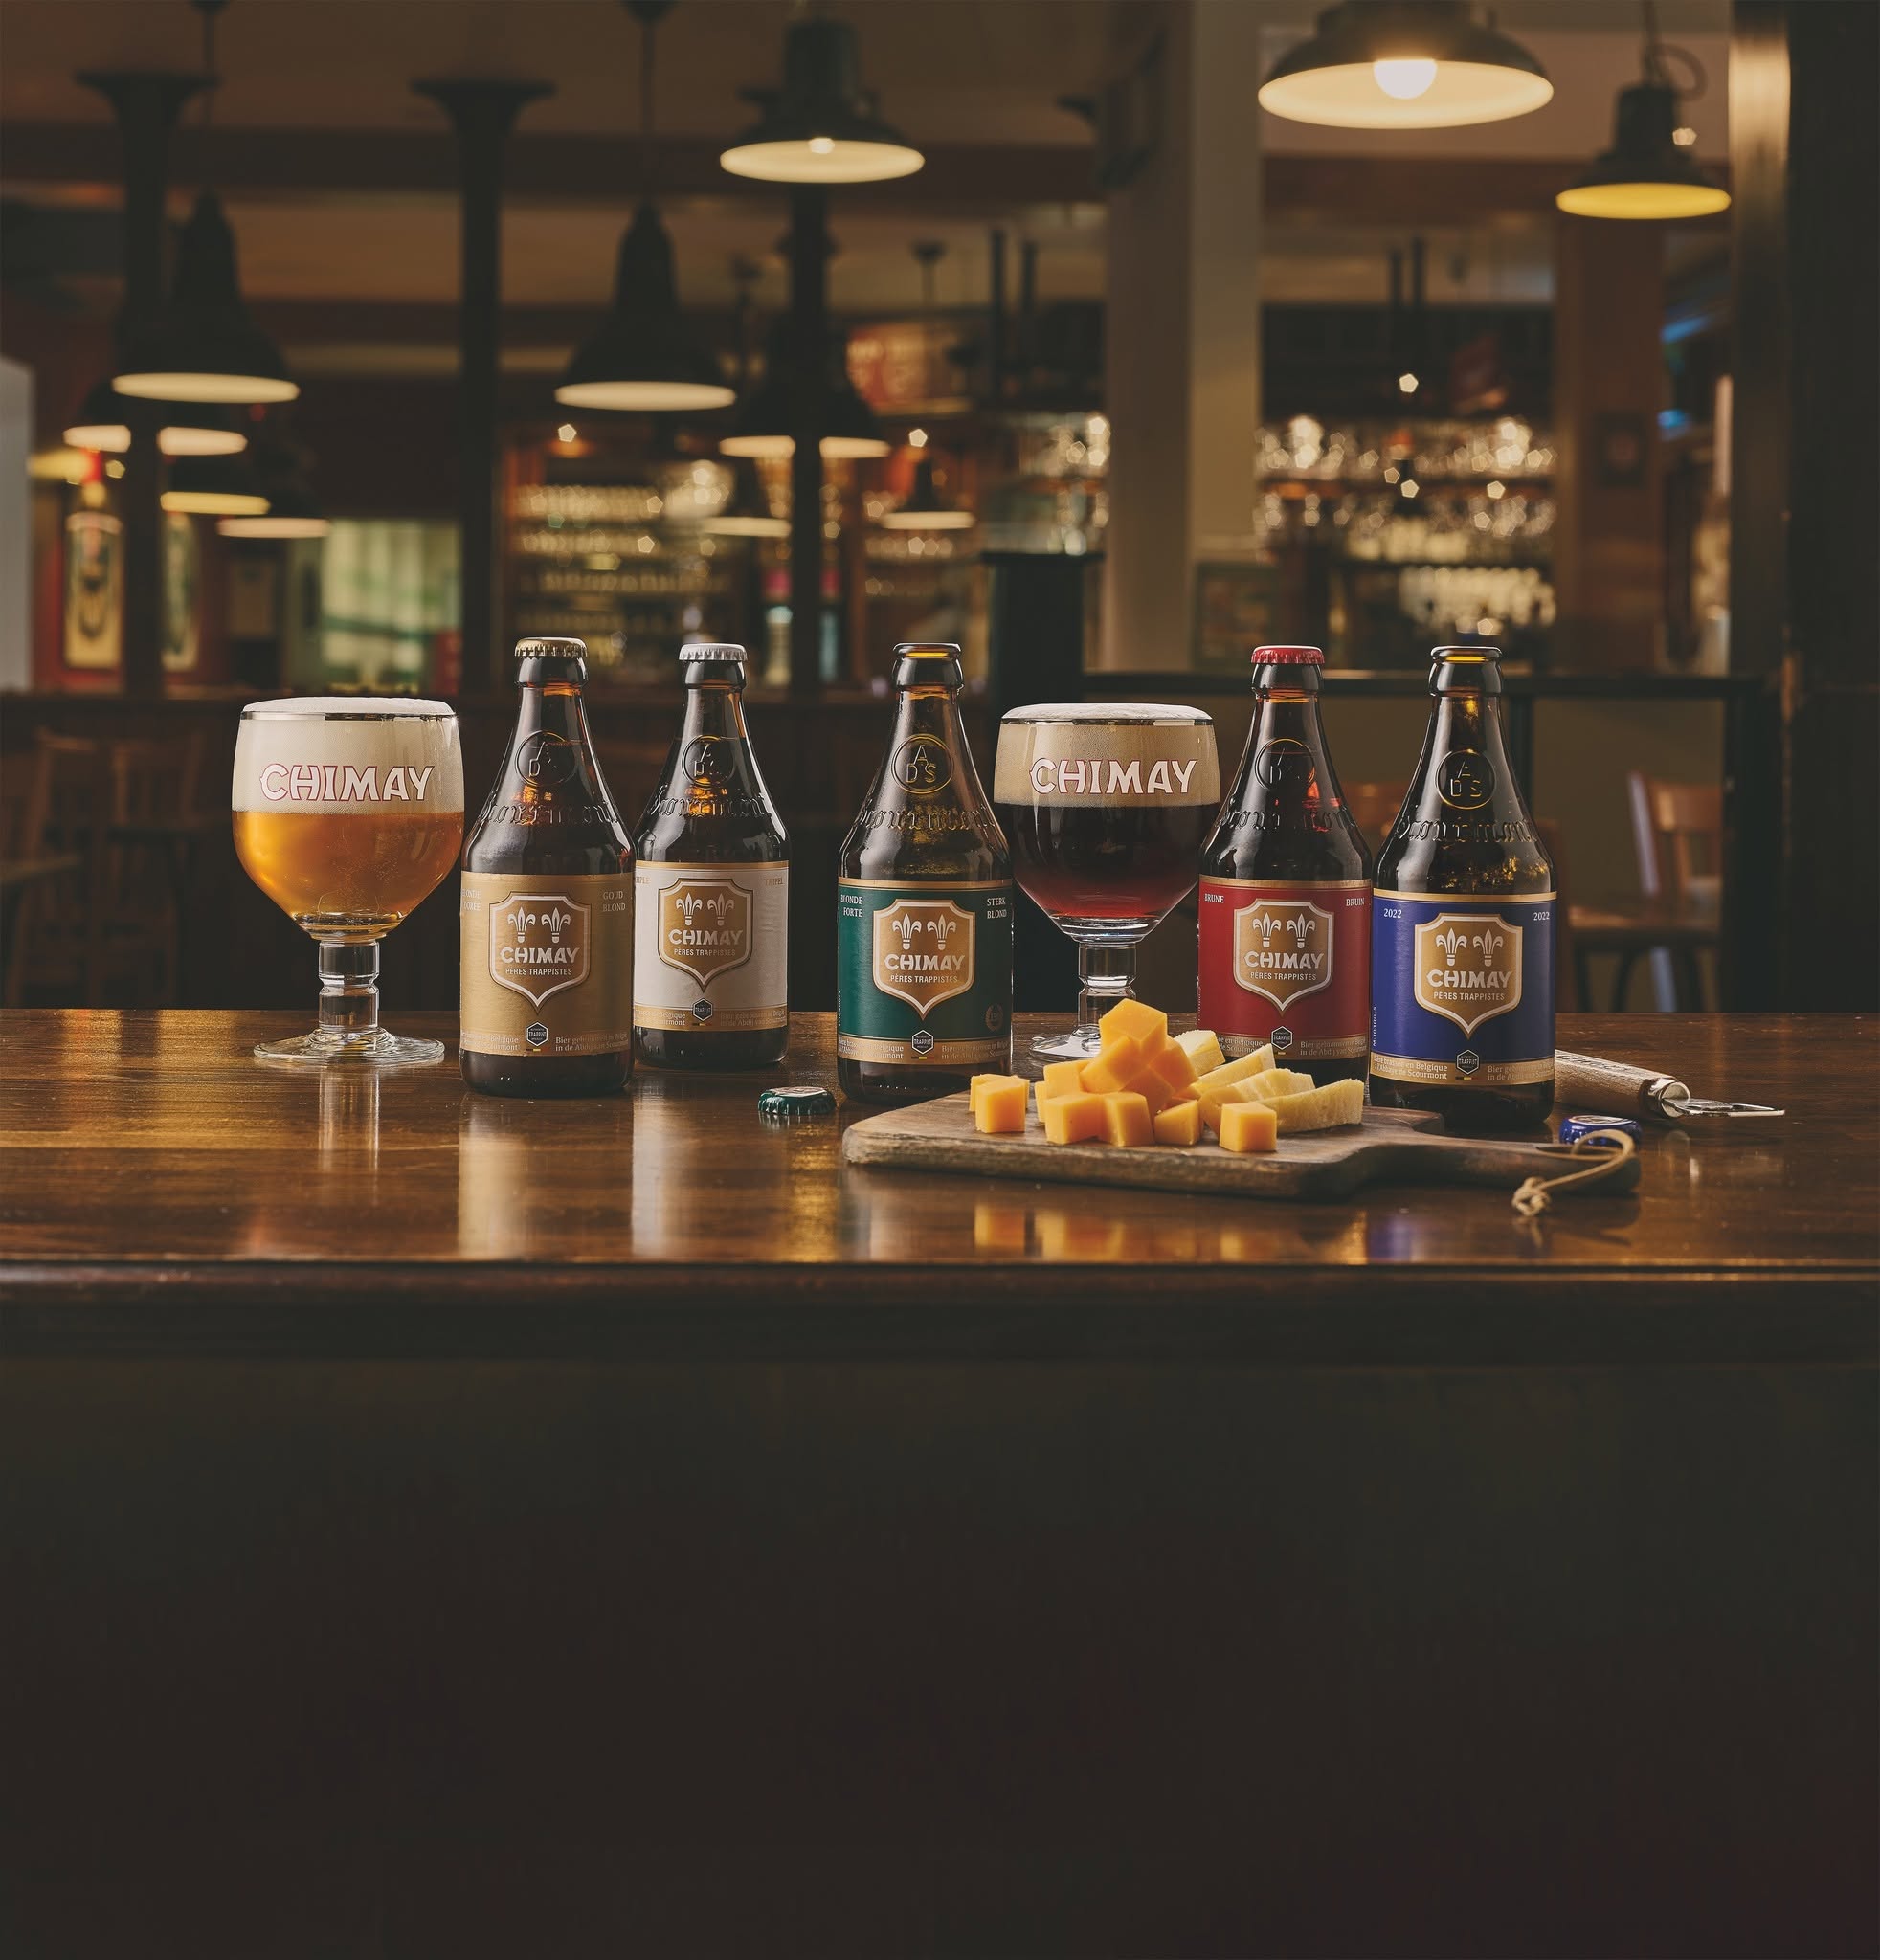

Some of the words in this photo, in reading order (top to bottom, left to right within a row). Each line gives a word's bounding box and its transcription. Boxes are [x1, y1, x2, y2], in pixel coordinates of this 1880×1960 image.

[1029, 757, 1197, 794] CHIMAY
[259, 764, 435, 801] CHIMAY
[603, 890, 623, 899] GOUD
[840, 894, 862, 904] BLONDE
[1205, 894, 1224, 903] BRUNE
[987, 897, 1006, 906] STERK
[1346, 898, 1364, 906] BRUIN
[602, 903, 626, 912] BLOND
[843, 907, 862, 917] FORTE
[987, 910, 1007, 919] BLOND
[1384, 908, 1402, 919] 2022
[1533, 911, 1550, 921] 2022
[668, 929, 744, 946] CHIMAY
[500, 947, 580, 964] CHIMAY
[1244, 950, 1324, 969] CHIMAY
[884, 953, 966, 971] CHIMAY
[891, 974, 912, 983] PÈRES
[1251, 970, 1272, 980] PÈRES
[1426, 969, 1512, 988] CHIMAY
[1434, 991, 1457, 1000] PÈRES
[1460, 992, 1505, 1001] TRAPPISTES
[1235, 1036, 1263, 1047] Belgique
[1227, 1044, 1256, 1053] Scourmo
[1417, 1062, 1447, 1072] Belgique
